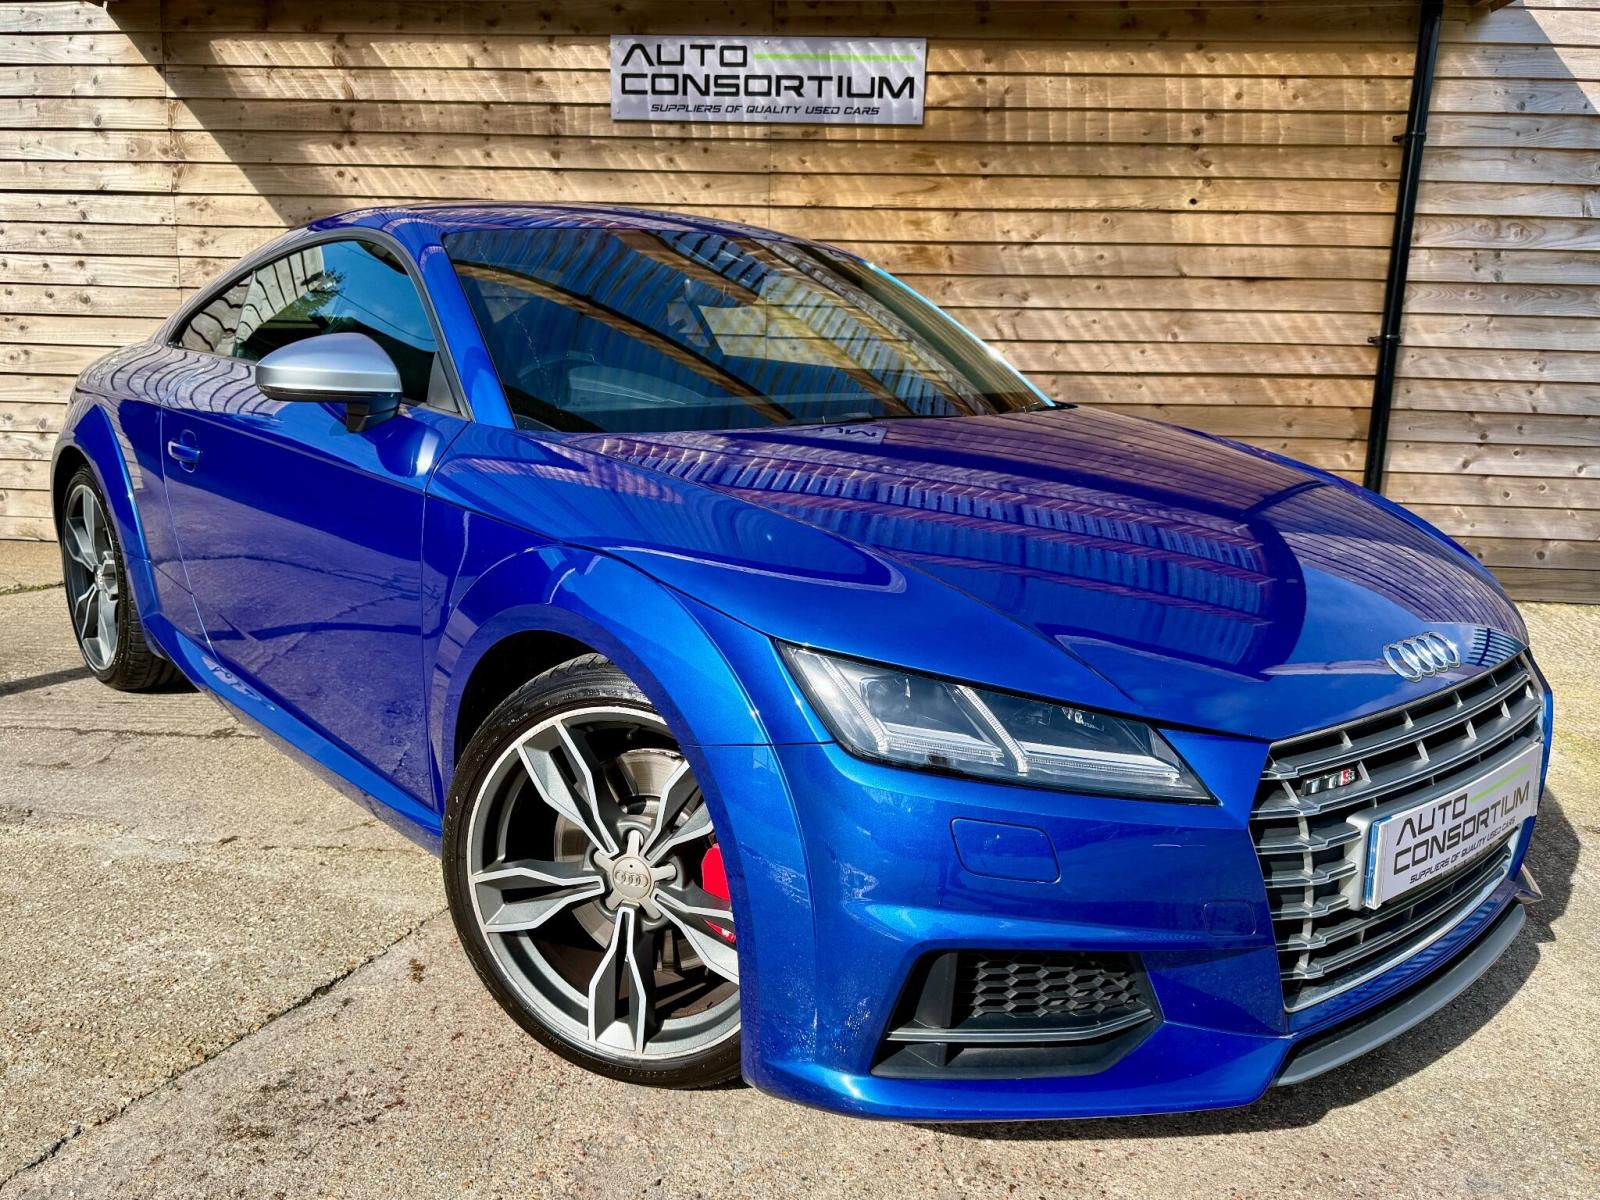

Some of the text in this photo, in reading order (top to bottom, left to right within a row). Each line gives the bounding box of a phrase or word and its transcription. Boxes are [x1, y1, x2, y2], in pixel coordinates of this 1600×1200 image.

[621, 43, 748, 68] AUTO
[620, 73, 915, 99] CONSORTIUM
[650, 103, 880, 116] SUPPLIERS OF QUALITY USED CARS
[1393, 780, 1530, 876] CONSORTIUM
[1396, 792, 1468, 847] AUTO
[1409, 857, 1451, 884] SUPPLIERS
[1450, 850, 1461, 864] OF
[1460, 836, 1487, 858] QUALITY
